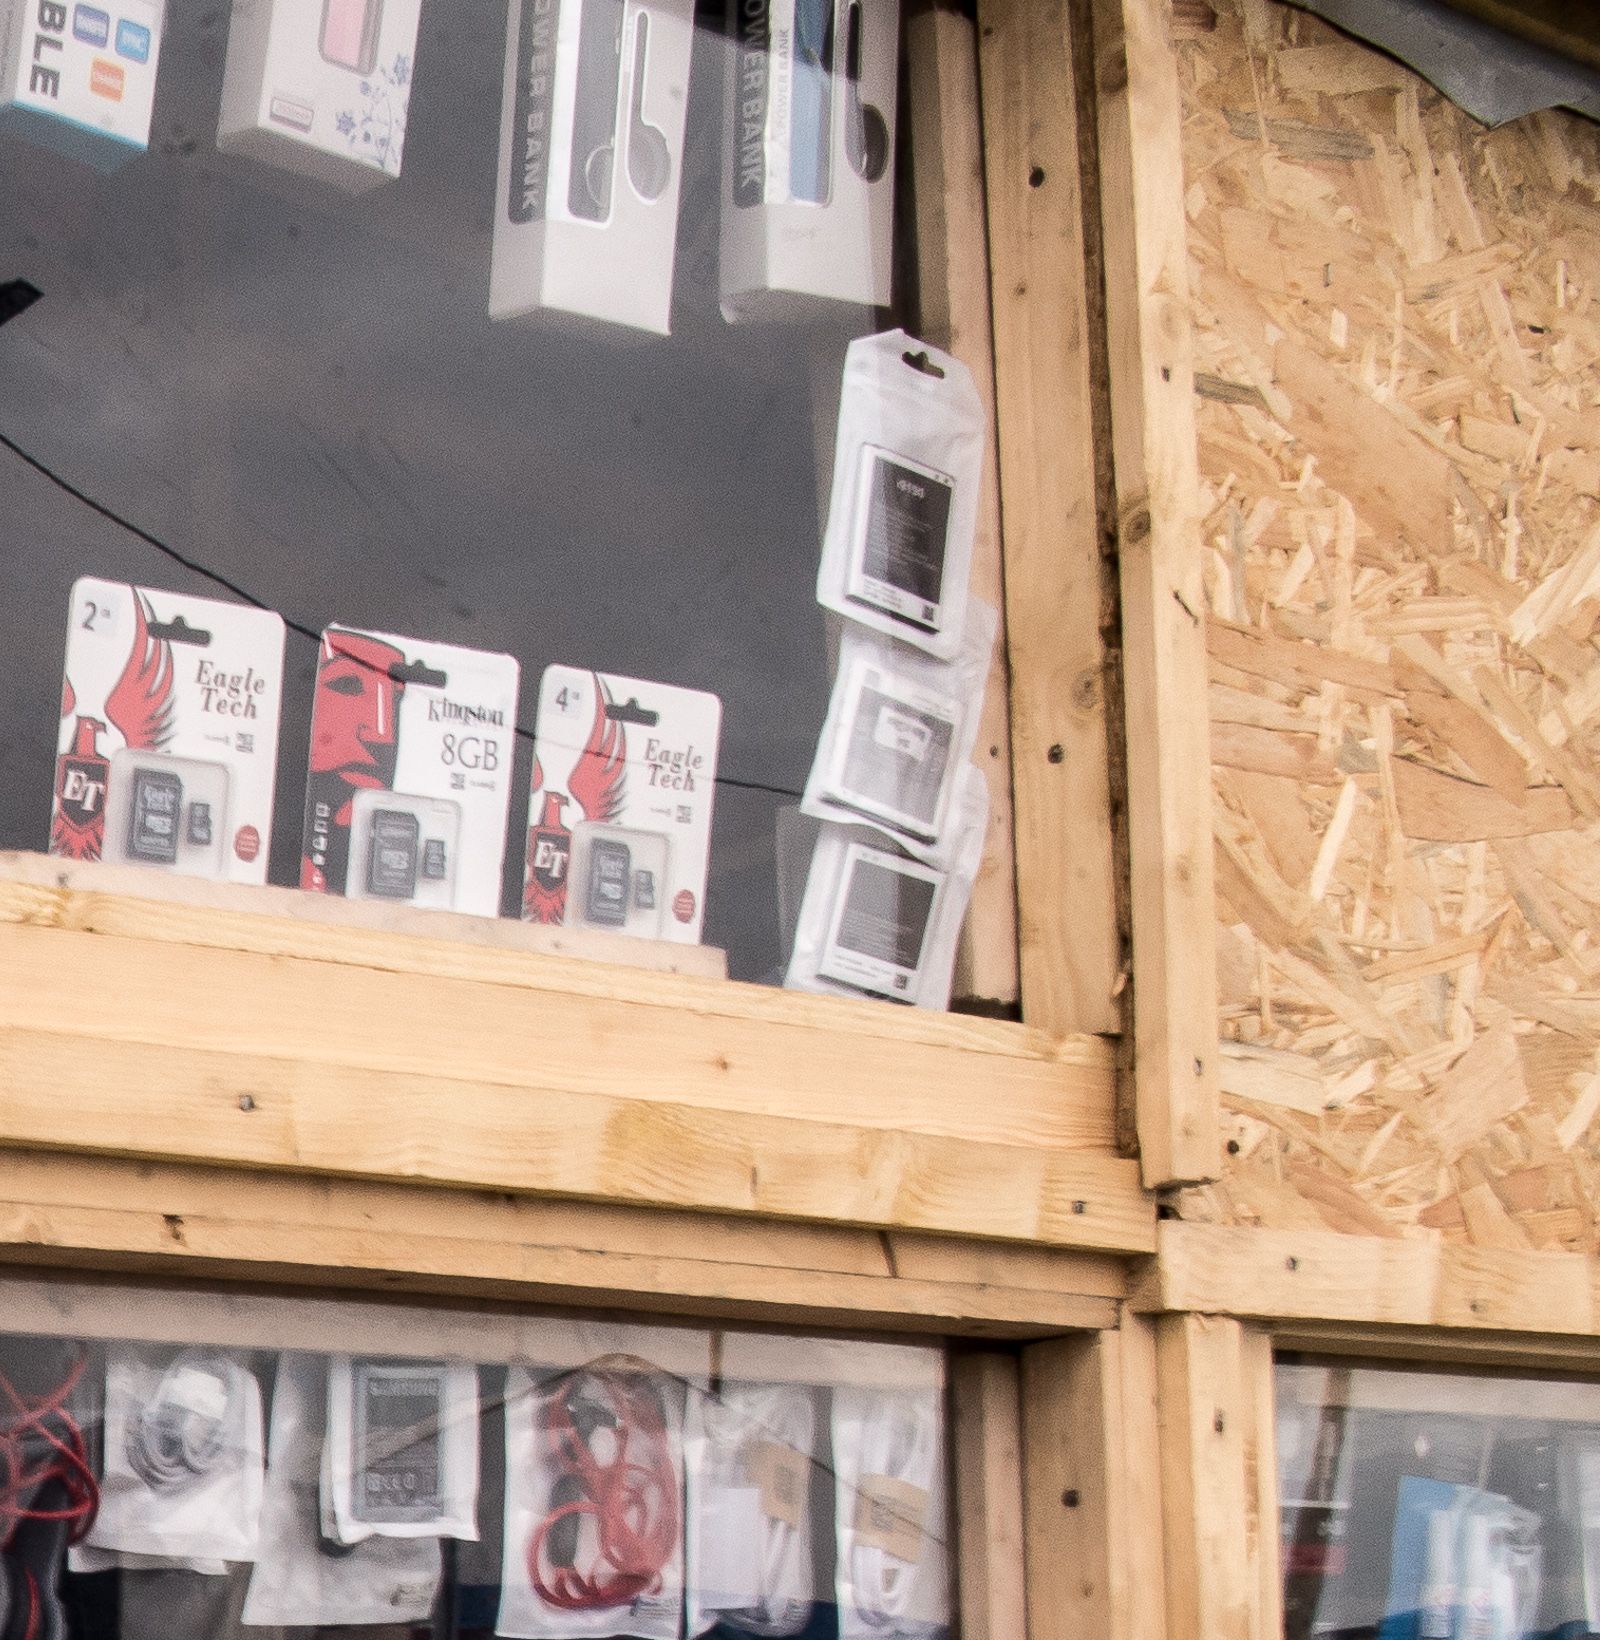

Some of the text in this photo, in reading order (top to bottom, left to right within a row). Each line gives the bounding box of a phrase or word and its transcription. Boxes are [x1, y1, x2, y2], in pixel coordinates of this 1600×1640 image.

[195, 659, 266, 698] Eagle
[200, 688, 258, 721] Tech
[427, 699, 505, 728] Kingston
[440, 733, 500, 772] 8GB
[643, 737, 703, 774] Eagle
[647, 763, 696, 793] Tech
